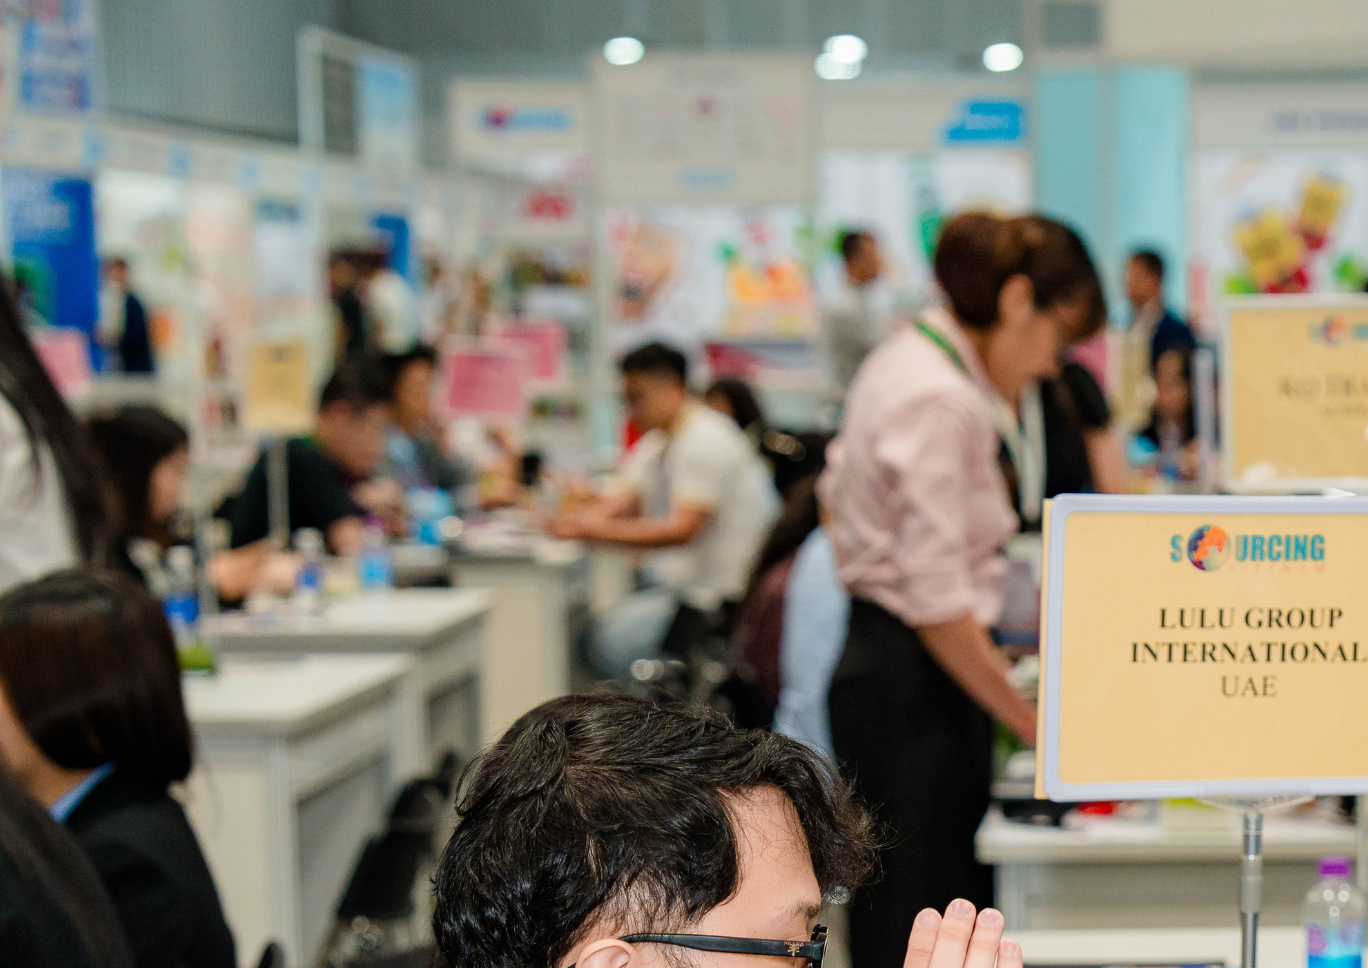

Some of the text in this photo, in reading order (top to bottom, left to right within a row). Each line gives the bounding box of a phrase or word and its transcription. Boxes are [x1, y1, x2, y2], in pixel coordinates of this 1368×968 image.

[1170, 525, 1326, 571] SOURCING
[1159, 606, 1344, 630] LULU GROUP
[1131, 641, 1368, 663] INTERNATIONAL
[1221, 674, 1278, 698] UAE
